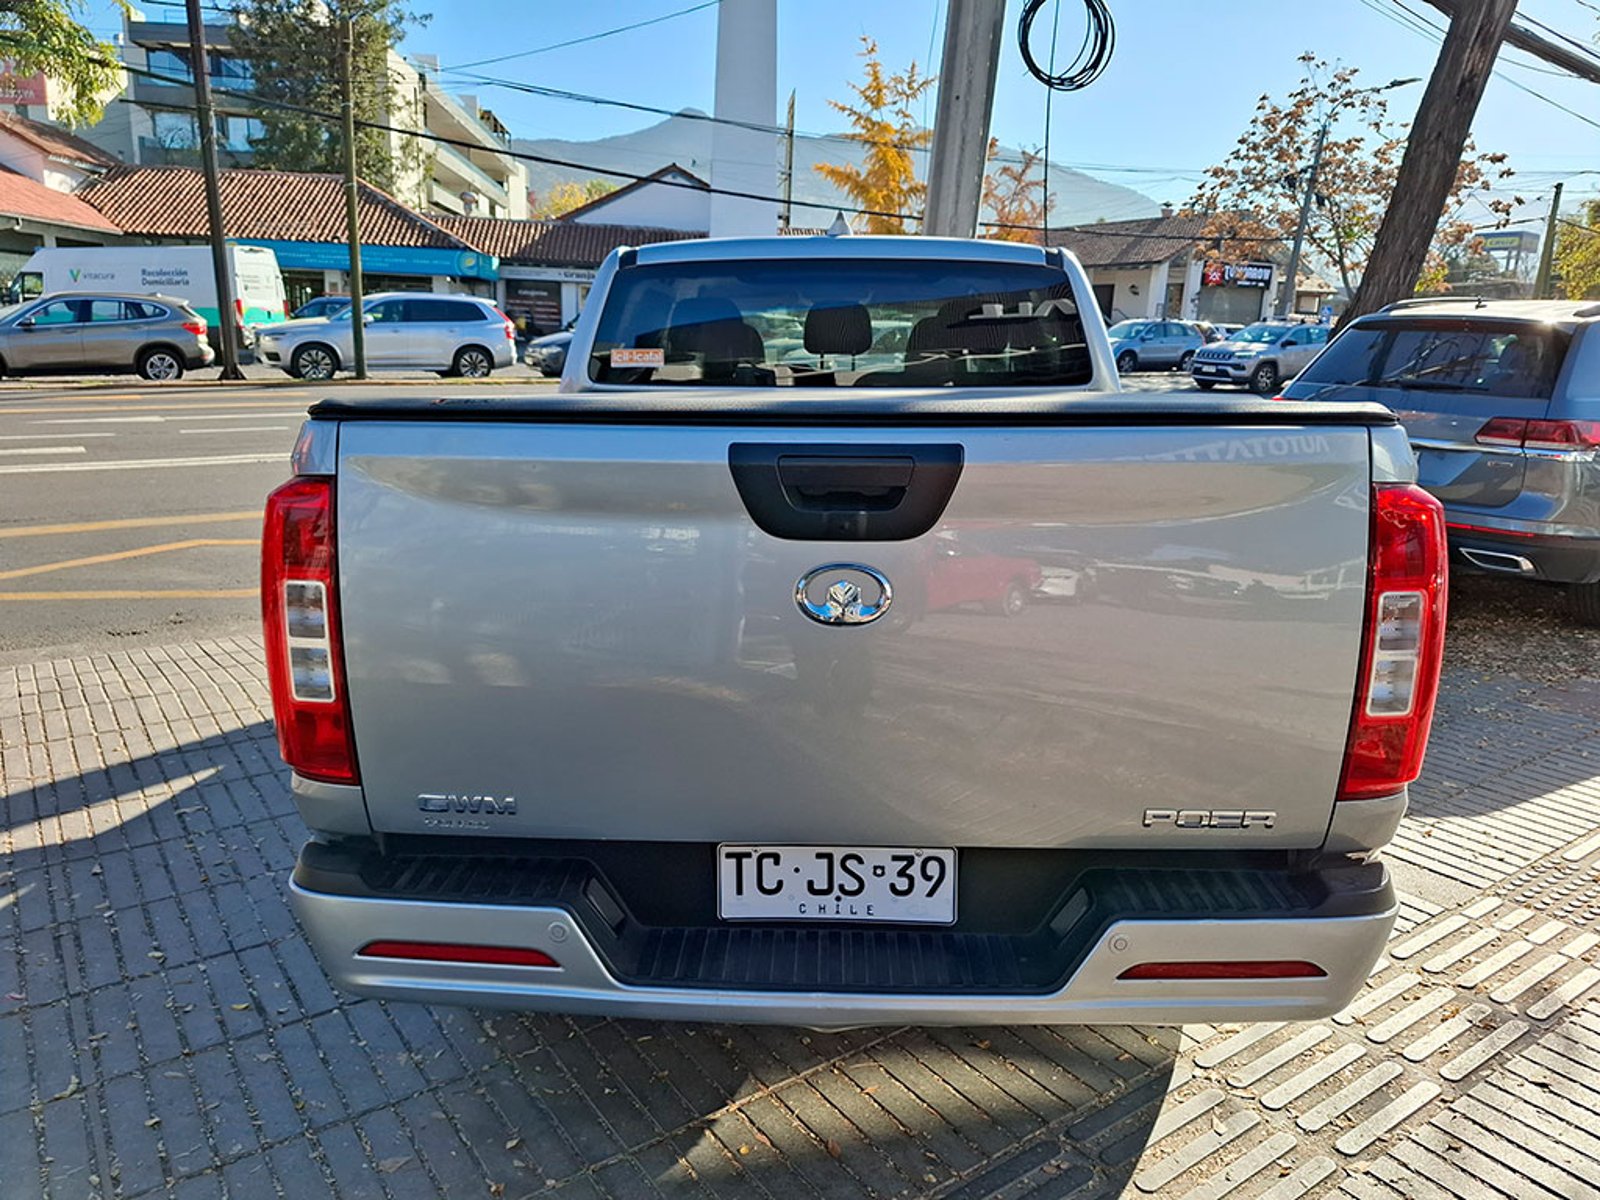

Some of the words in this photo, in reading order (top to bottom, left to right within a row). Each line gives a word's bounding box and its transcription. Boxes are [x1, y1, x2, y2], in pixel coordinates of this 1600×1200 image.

[141, 267, 189, 277] Recolección
[142, 277, 190, 287] Domiciliaria
[417, 793, 517, 815] GWM
[1143, 808, 1277, 828] POER
[799, 903, 875, 916] CHILE
